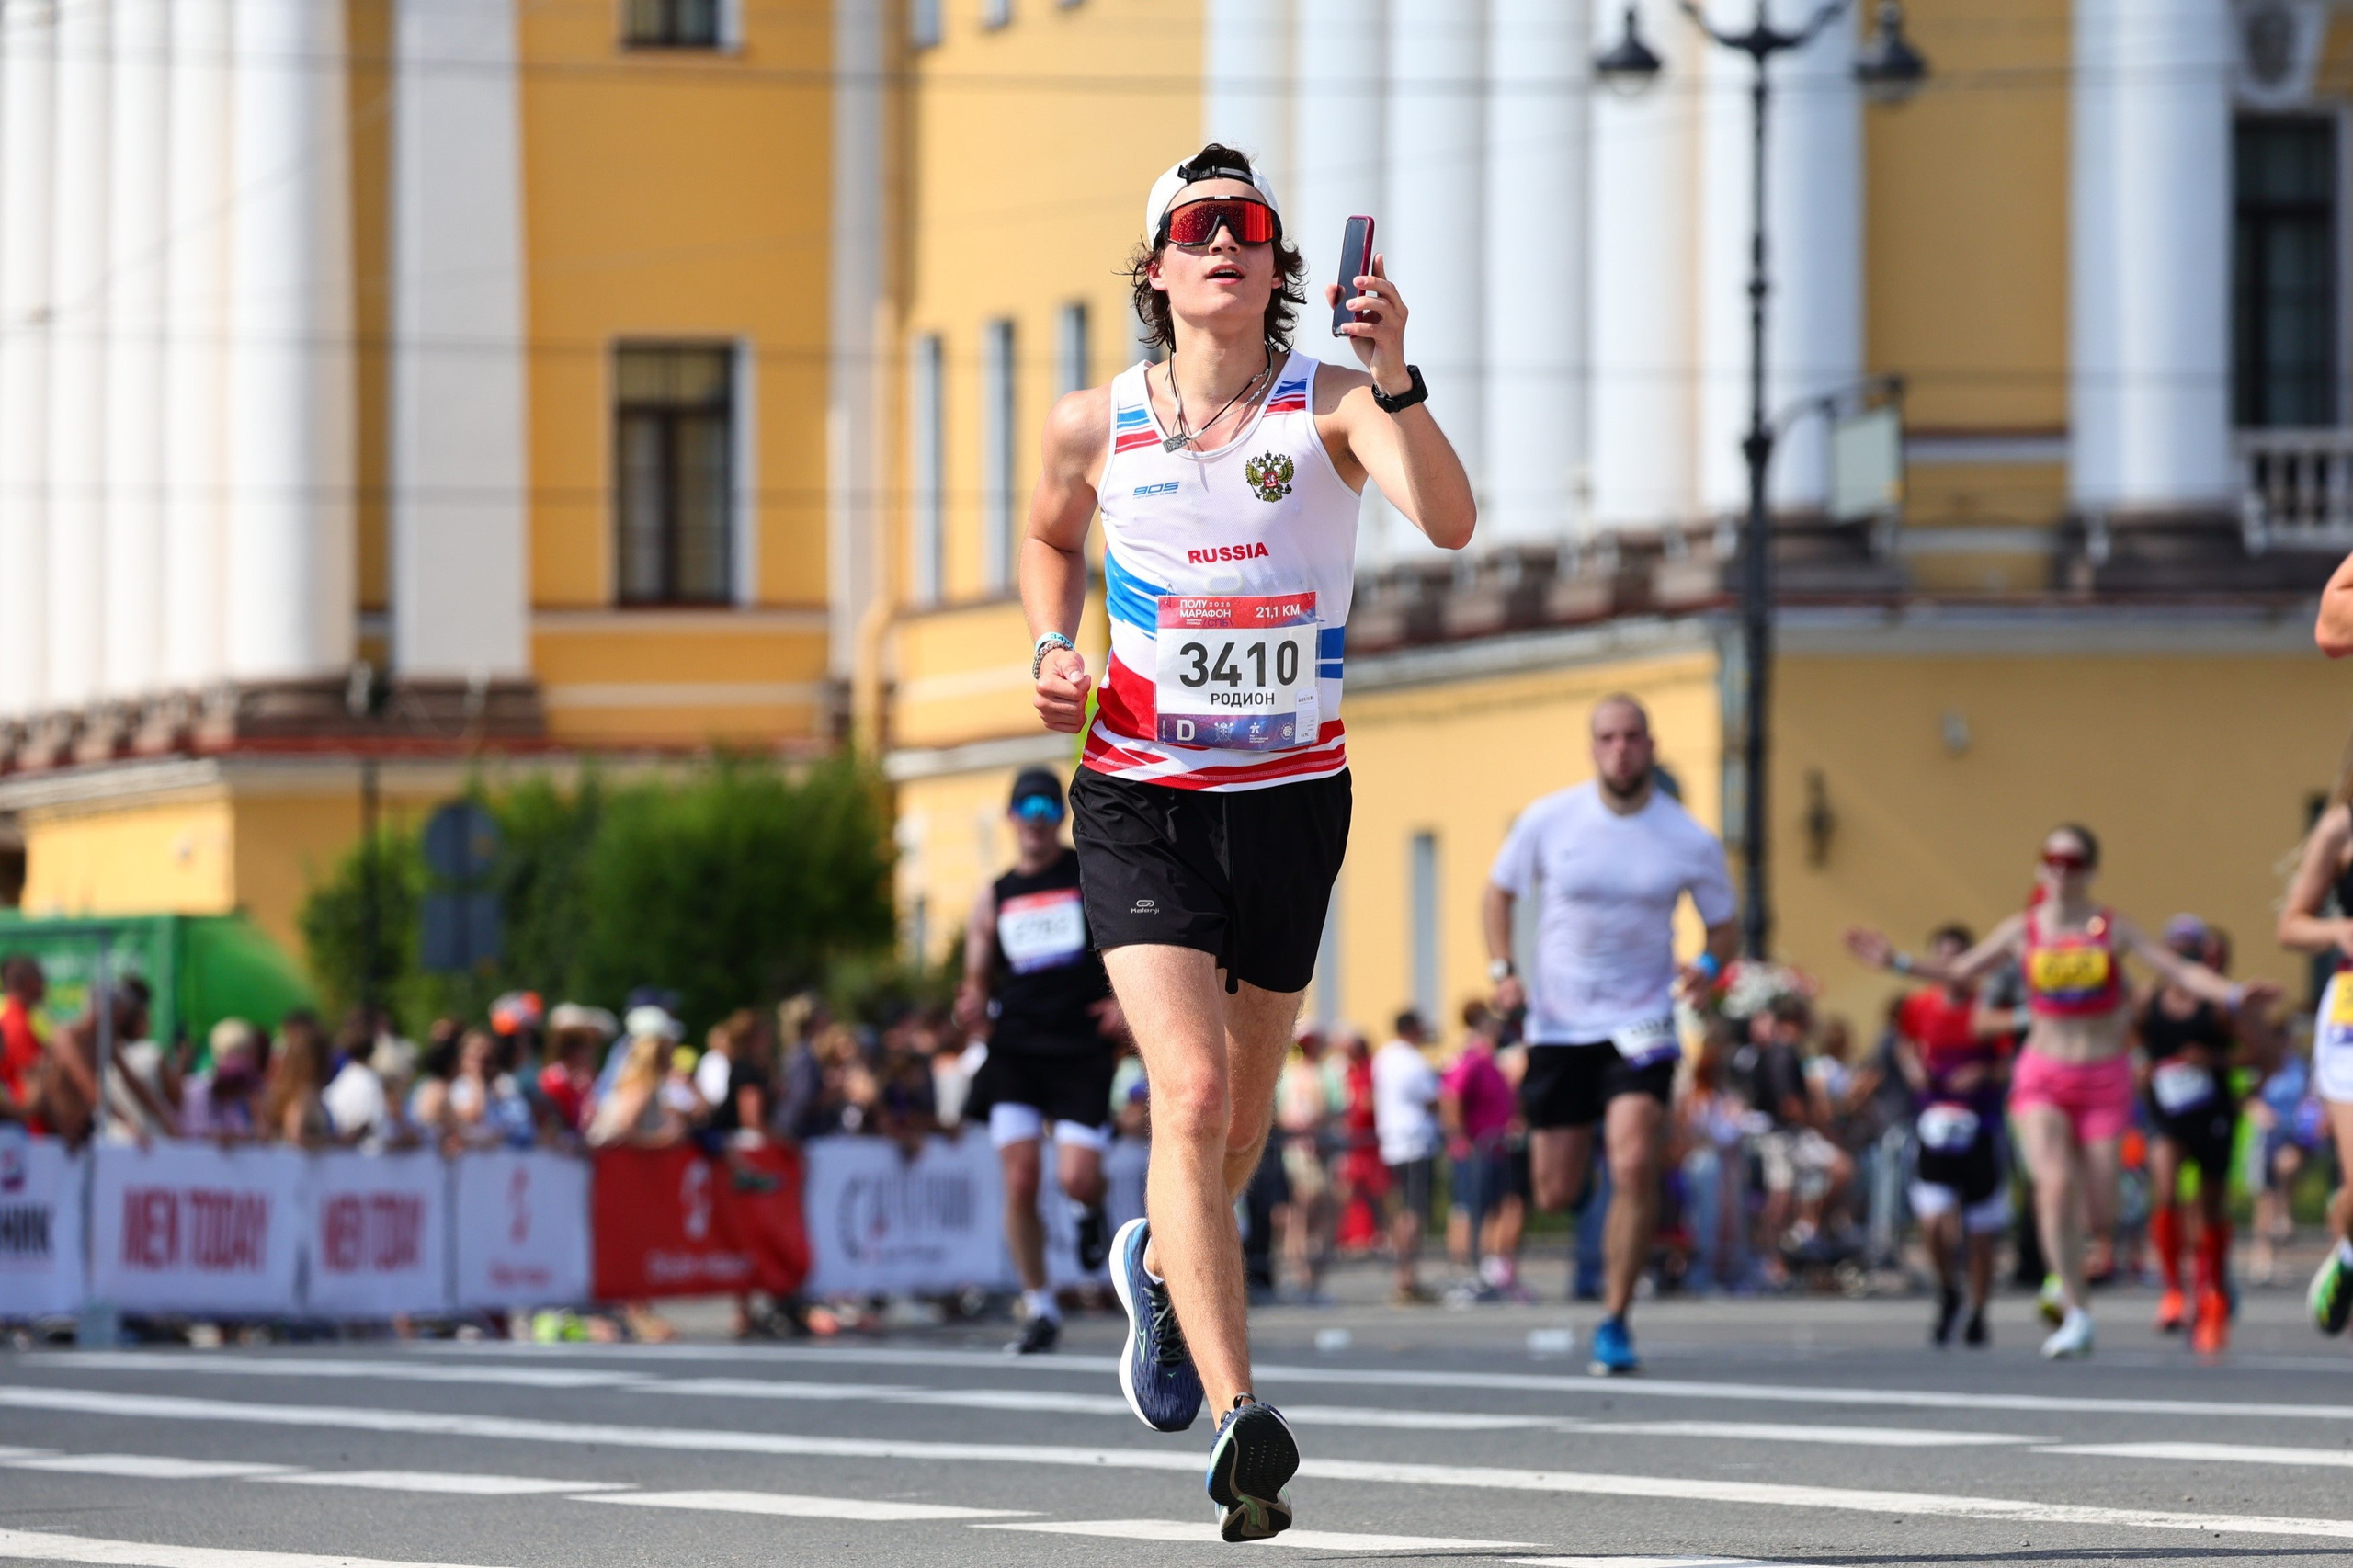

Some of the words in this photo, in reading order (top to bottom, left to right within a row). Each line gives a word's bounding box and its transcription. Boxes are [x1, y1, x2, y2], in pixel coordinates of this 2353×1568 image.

[1133, 481, 1180, 495] 905
[1188, 542, 1269, 564] RUSSIA
[1180, 599, 1207, 608] ПОЛУ
[1256, 606, 1279, 619] 21,1
[1282, 603, 1300, 617] КМ
[1179, 608, 1232, 618] МАРАФОН
[1179, 640, 1299, 688] 3410
[1211, 692, 1275, 708] РОДИОН
[1177, 719, 1195, 742] D
